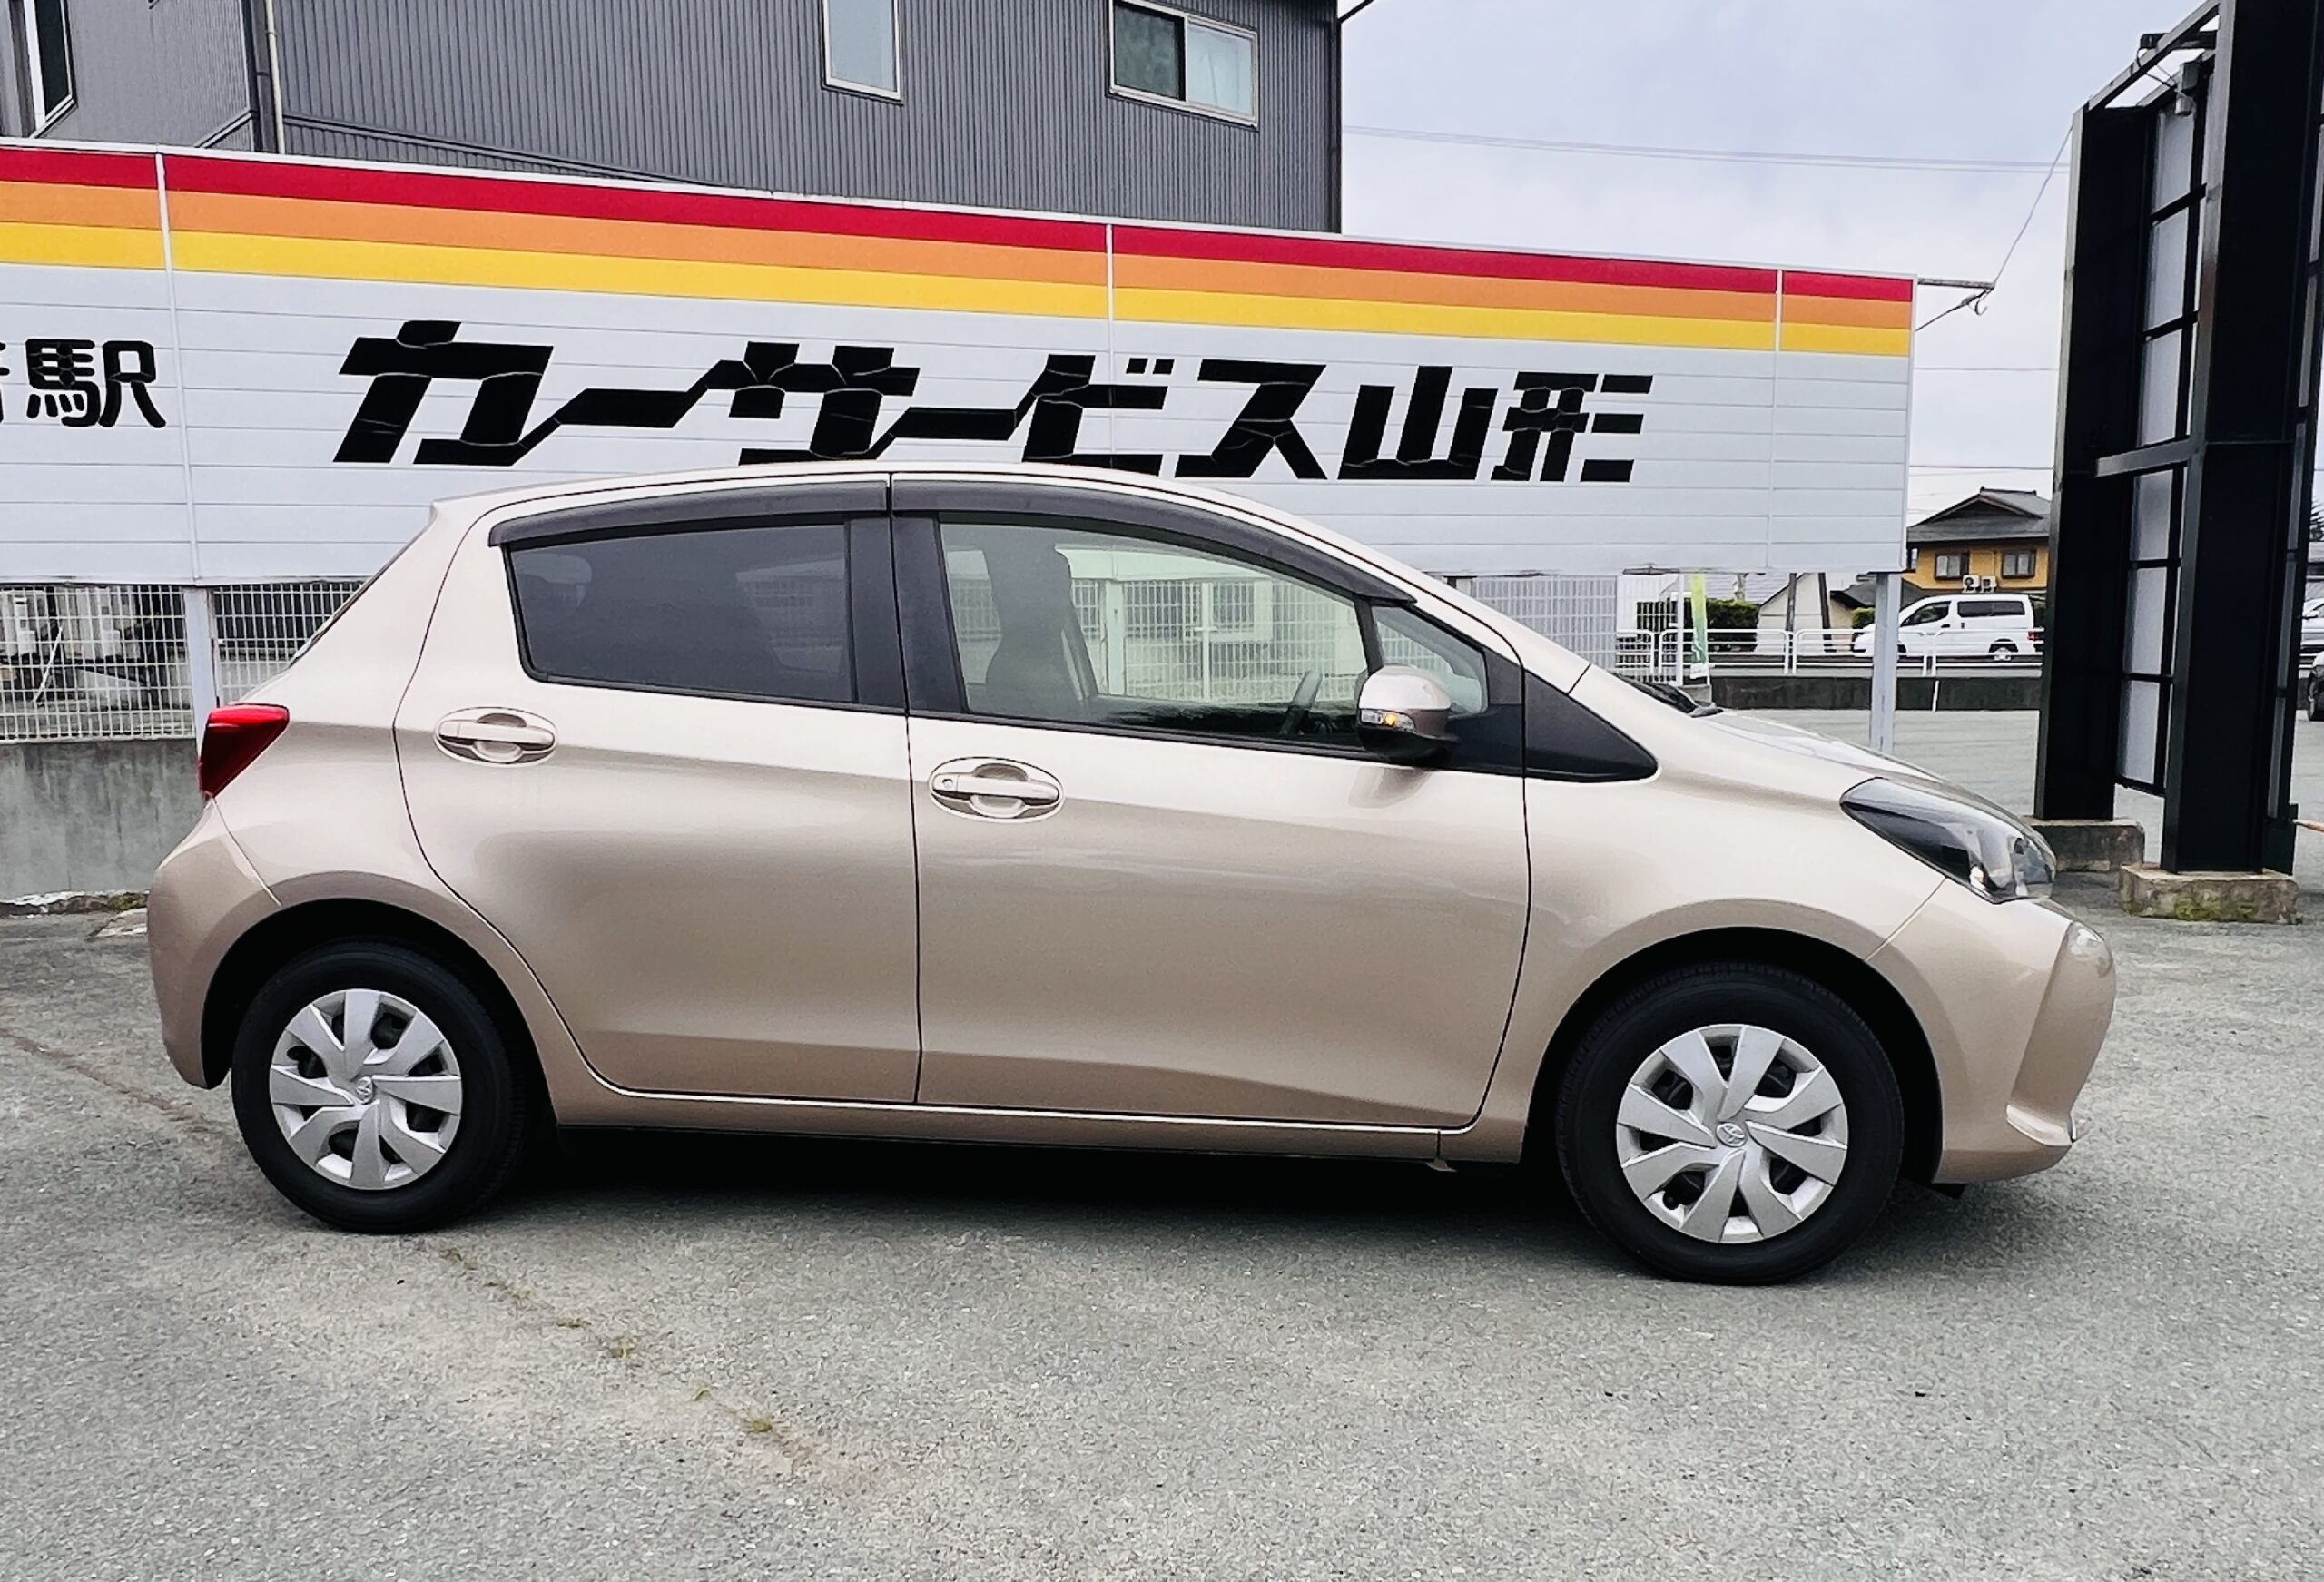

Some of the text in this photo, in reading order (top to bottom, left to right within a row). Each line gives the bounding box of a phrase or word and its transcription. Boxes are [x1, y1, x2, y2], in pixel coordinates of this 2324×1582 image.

[0, 339, 166, 429] 駅
[333, 320, 1653, 483] カーサービス山形
